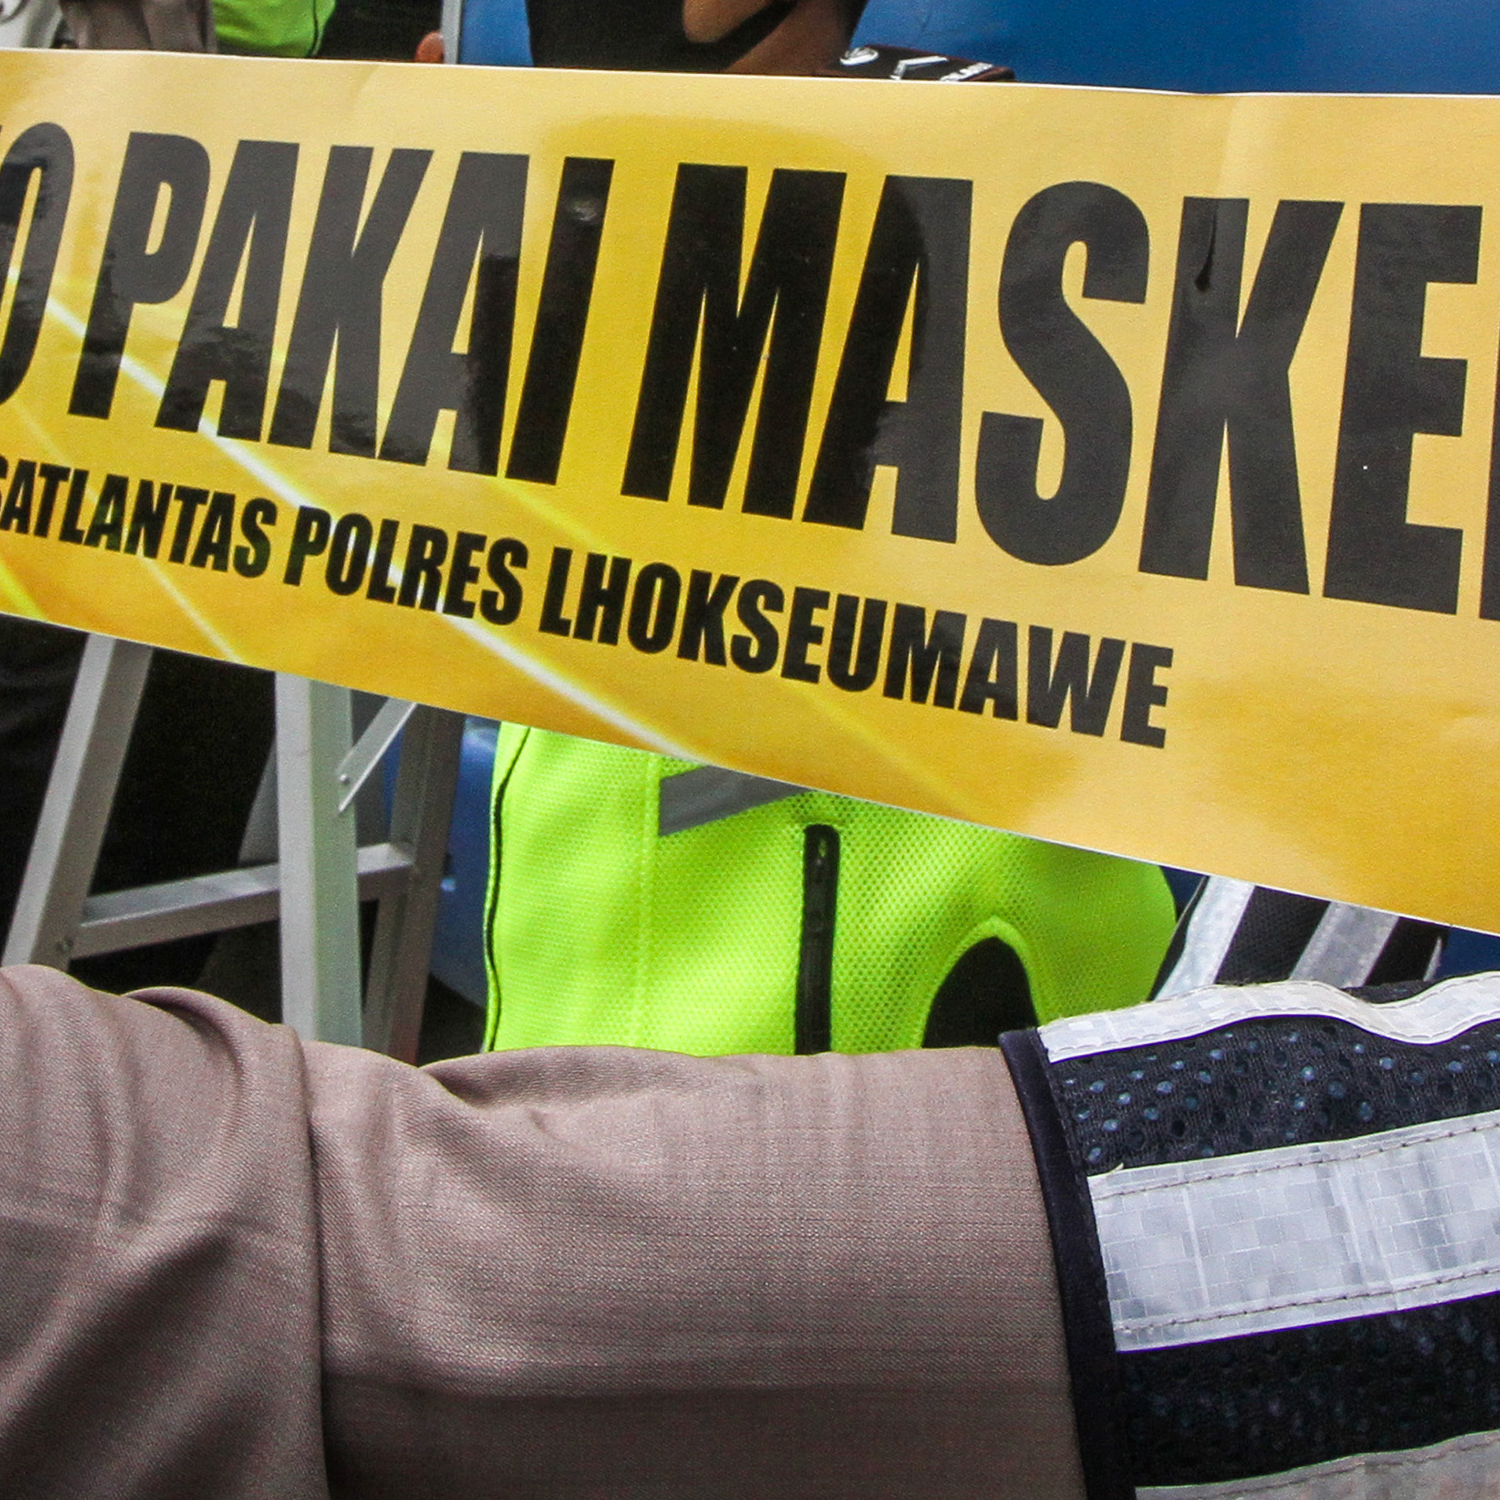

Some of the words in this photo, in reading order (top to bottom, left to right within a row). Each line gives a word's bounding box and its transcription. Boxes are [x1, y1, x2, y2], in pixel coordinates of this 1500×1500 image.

[67, 130, 616, 486] PAKAI
[282, 504, 529, 626] POLRES
[538, 546, 1174, 750] LHOKSEUMAWE
